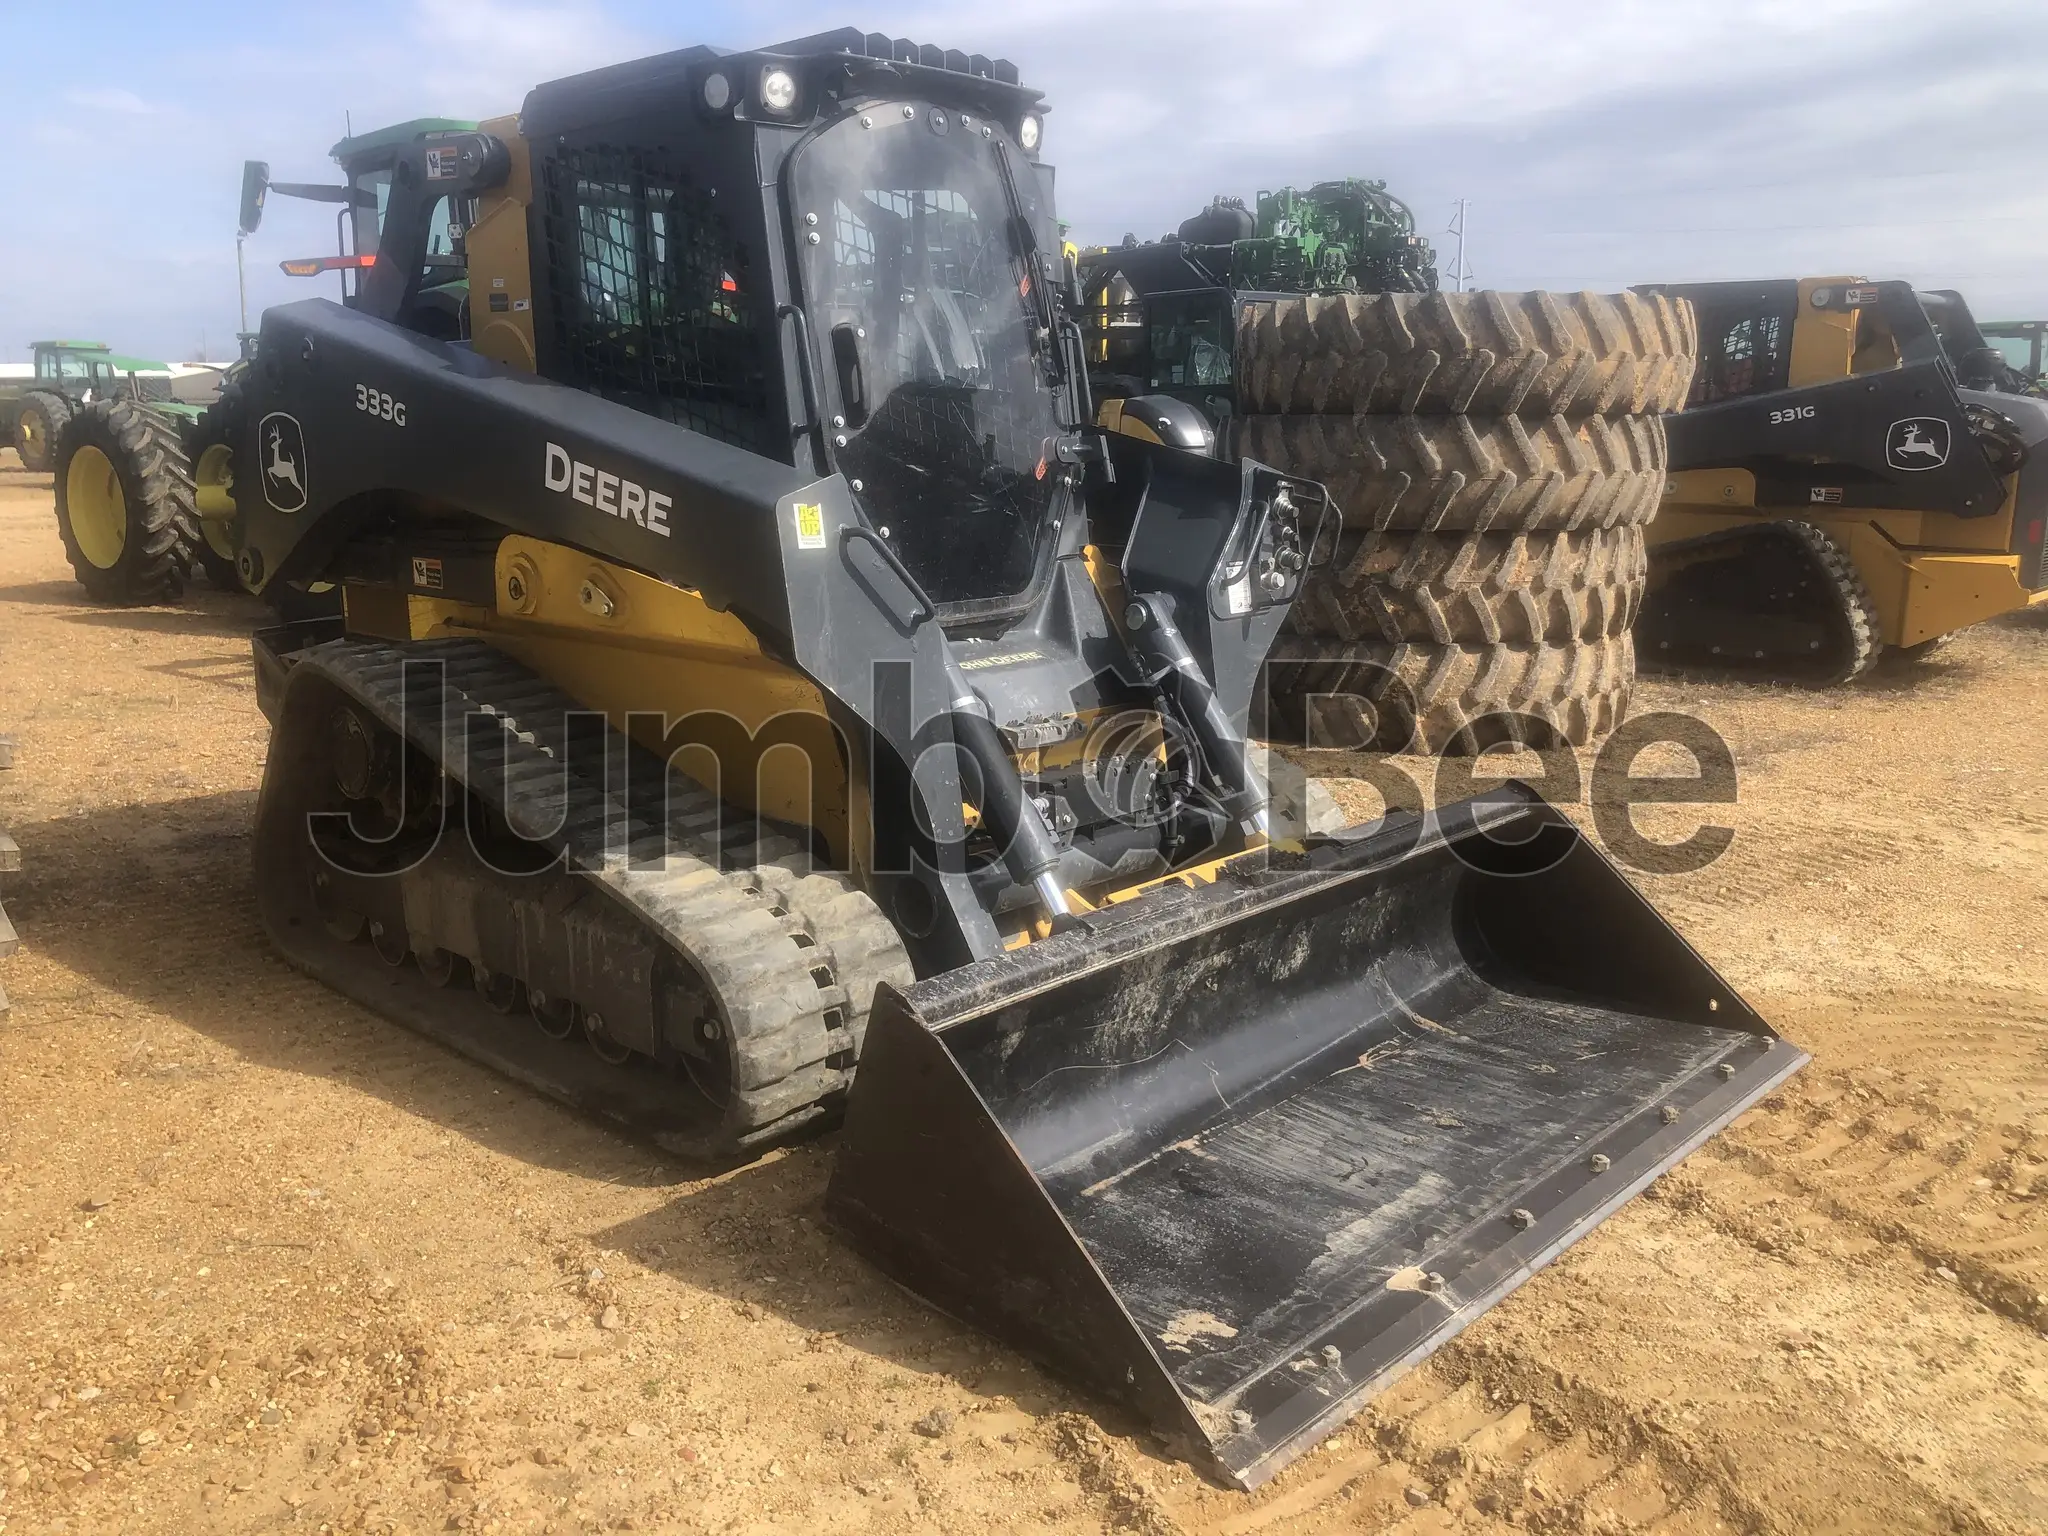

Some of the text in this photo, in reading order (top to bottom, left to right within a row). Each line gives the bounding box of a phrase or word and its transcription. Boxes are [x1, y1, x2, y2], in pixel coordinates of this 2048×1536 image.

[356, 383, 406, 427] 333G
[1769, 405, 1815, 424] 331G
[544, 441, 673, 538] DEERE
[958, 658, 993, 670] OHN
